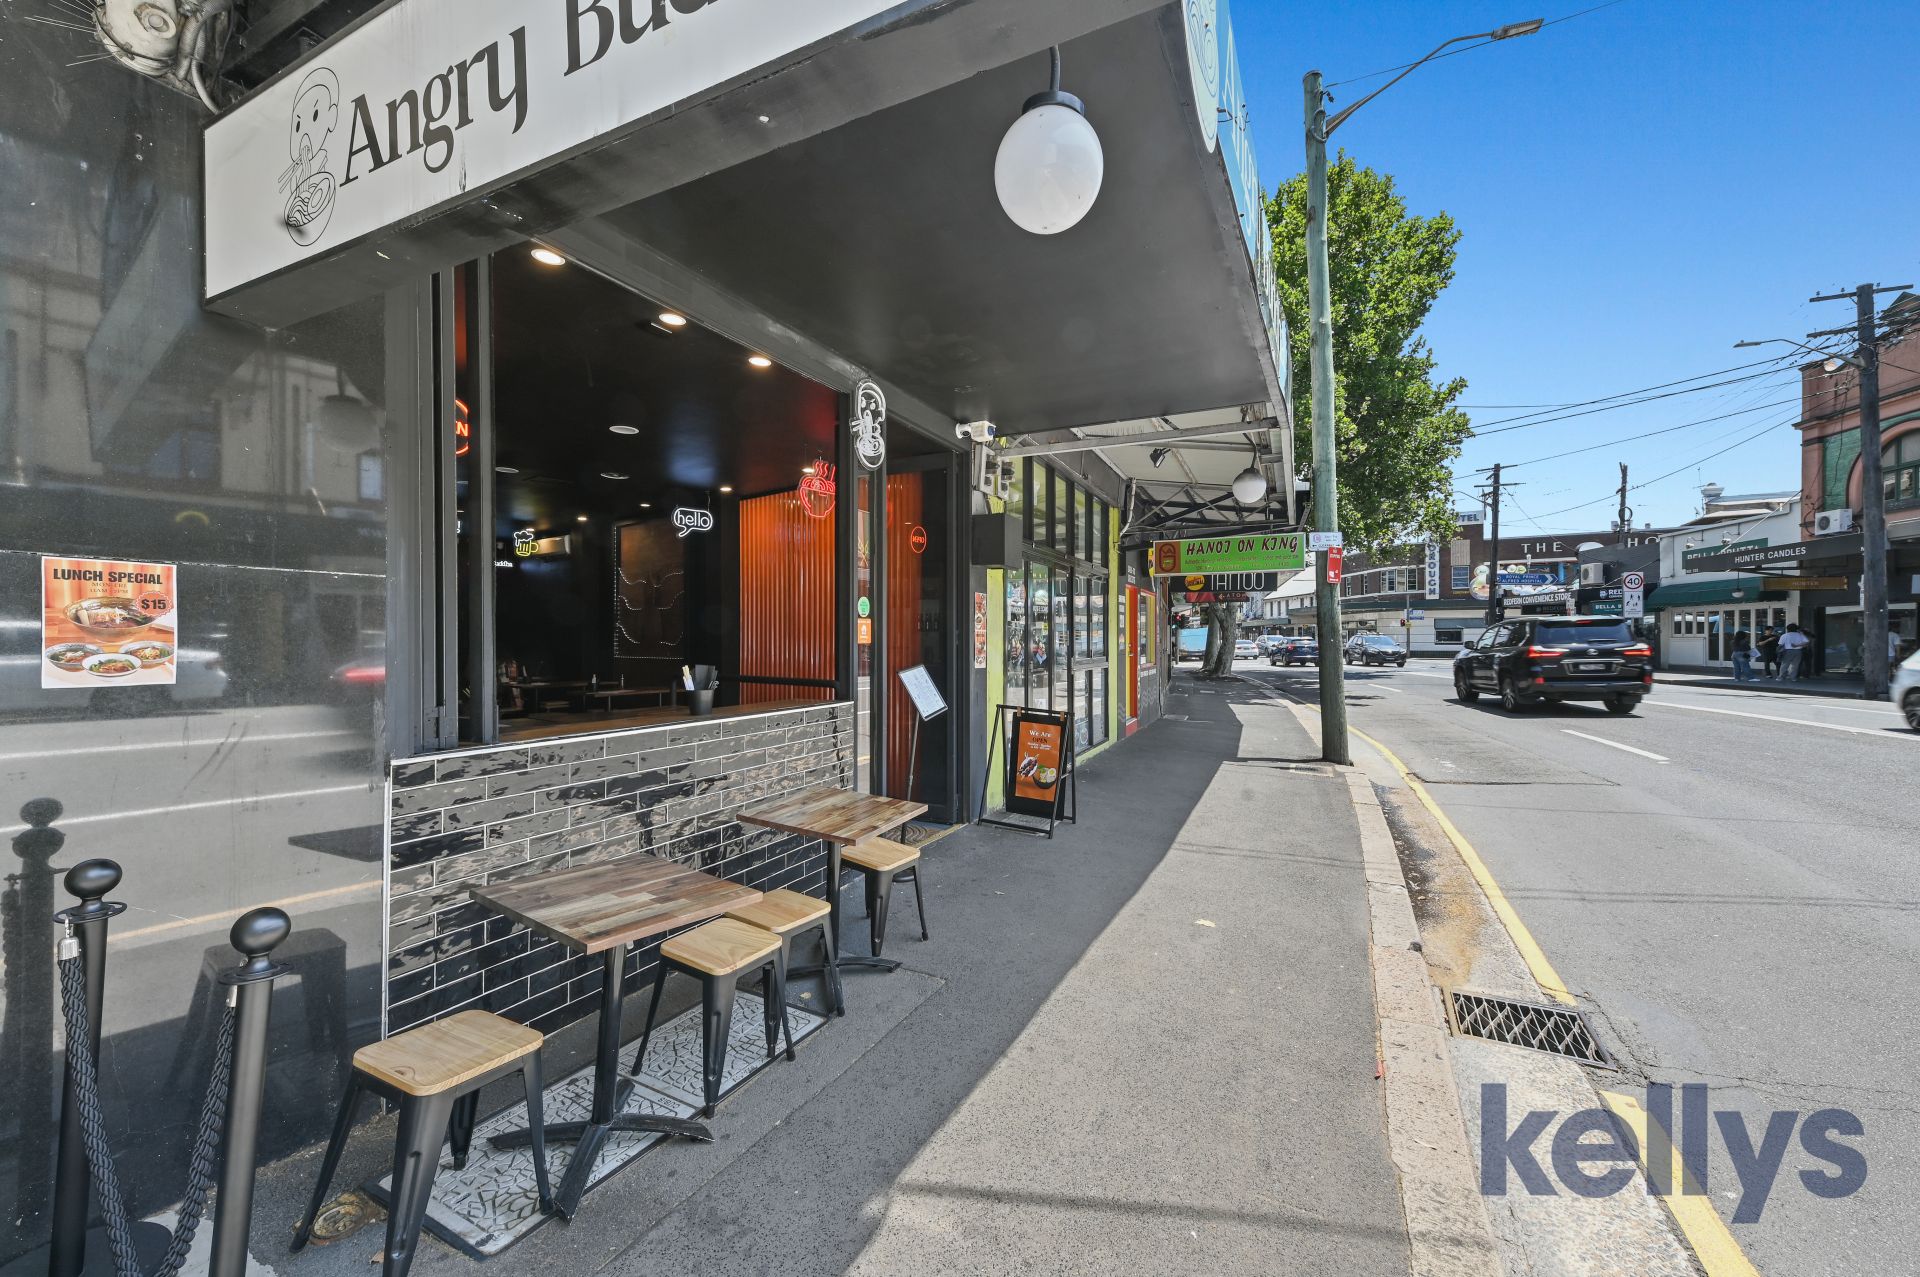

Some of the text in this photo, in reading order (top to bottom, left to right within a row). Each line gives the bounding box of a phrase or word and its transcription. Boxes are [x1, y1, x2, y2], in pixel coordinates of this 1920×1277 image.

[339, 25, 528, 188] Angry
[677, 510, 710, 528] hello
[1457, 513, 1479, 523] TEL
[1237, 539, 1254, 552] ON
[1261, 536, 1298, 553] KING
[1521, 541, 1563, 554] THE
[1734, 546, 1806, 564] HUNTER CANDLES
[53, 568, 163, 585] LUNCH SPECIAL
[1627, 577, 1640, 586] 40
[141, 598, 167, 610] $15
[1503, 592, 1572, 606] REDFERN CONVENIENCE STORE
